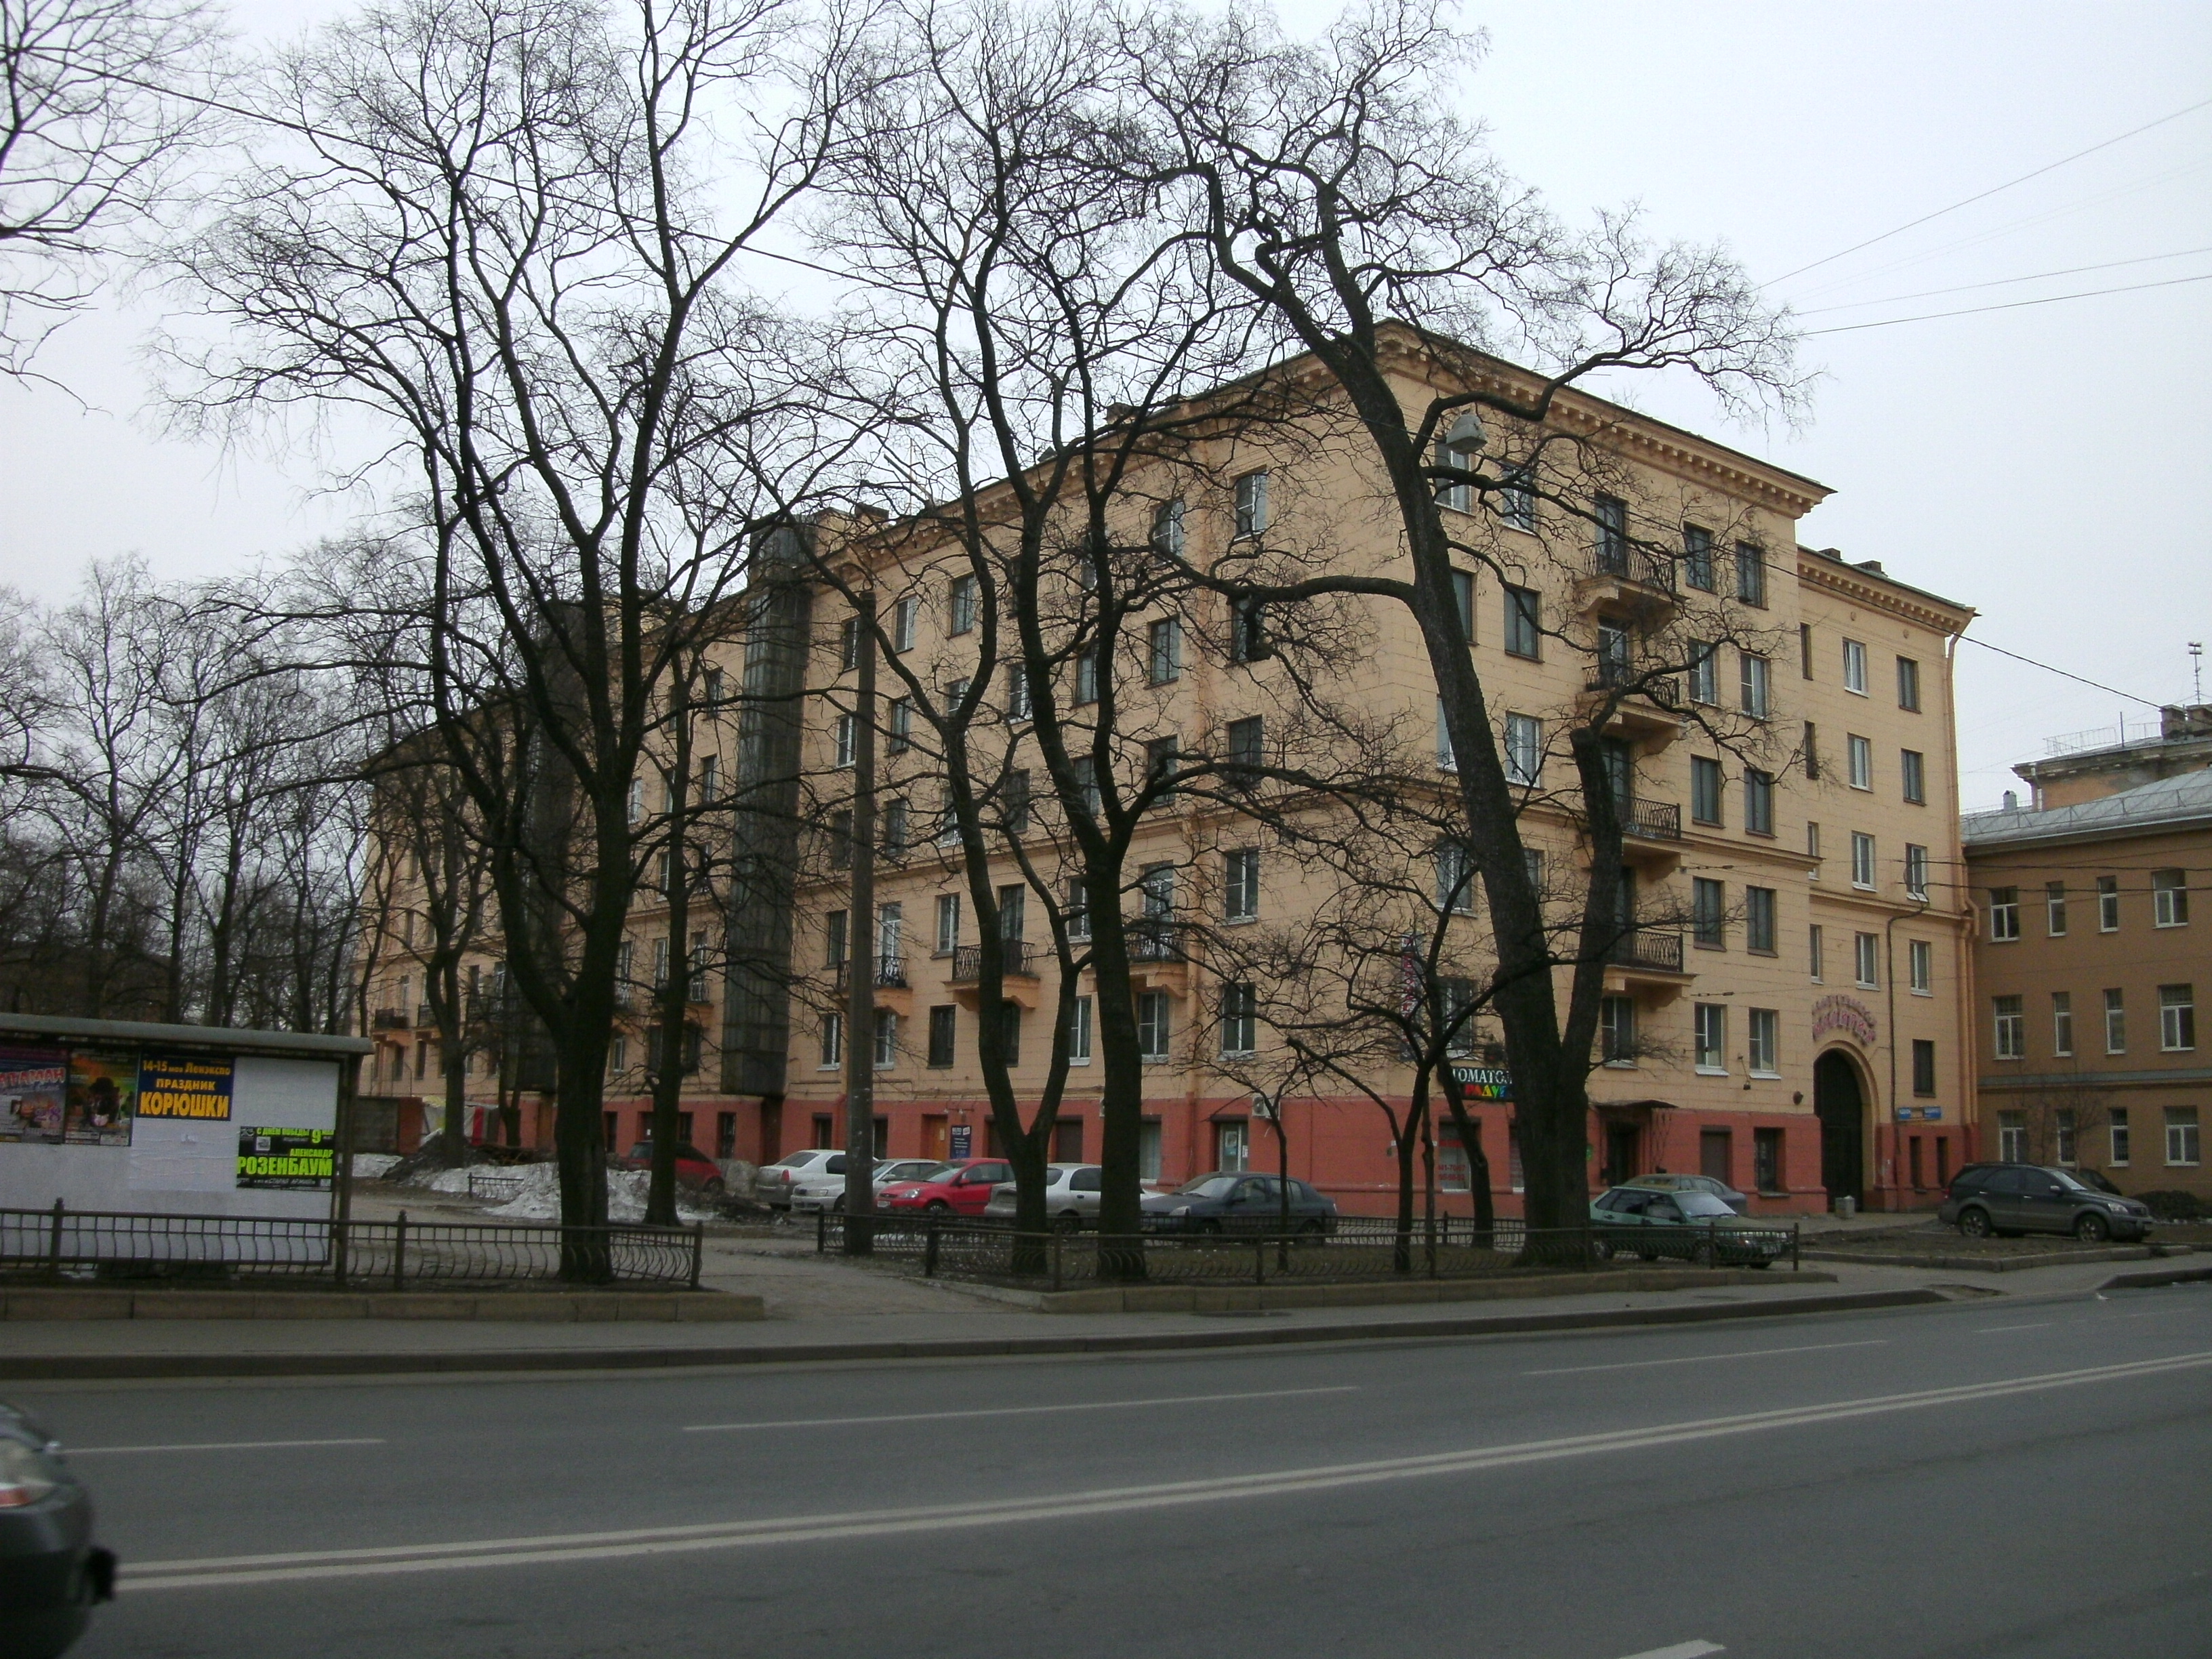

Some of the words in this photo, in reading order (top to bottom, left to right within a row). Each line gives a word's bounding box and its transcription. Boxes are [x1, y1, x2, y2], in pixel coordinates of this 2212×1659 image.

[143, 1060, 168, 1071] 14-15
[156, 1078, 216, 1090] ПРАЗДНИК
[1465, 1084, 1509, 1099] РАДУГ
[140, 1091, 229, 1118] КОРЮШКИ
[312, 1129, 321, 1143] 9
[237, 1156, 333, 1176] РОЗЕНБАУМ
